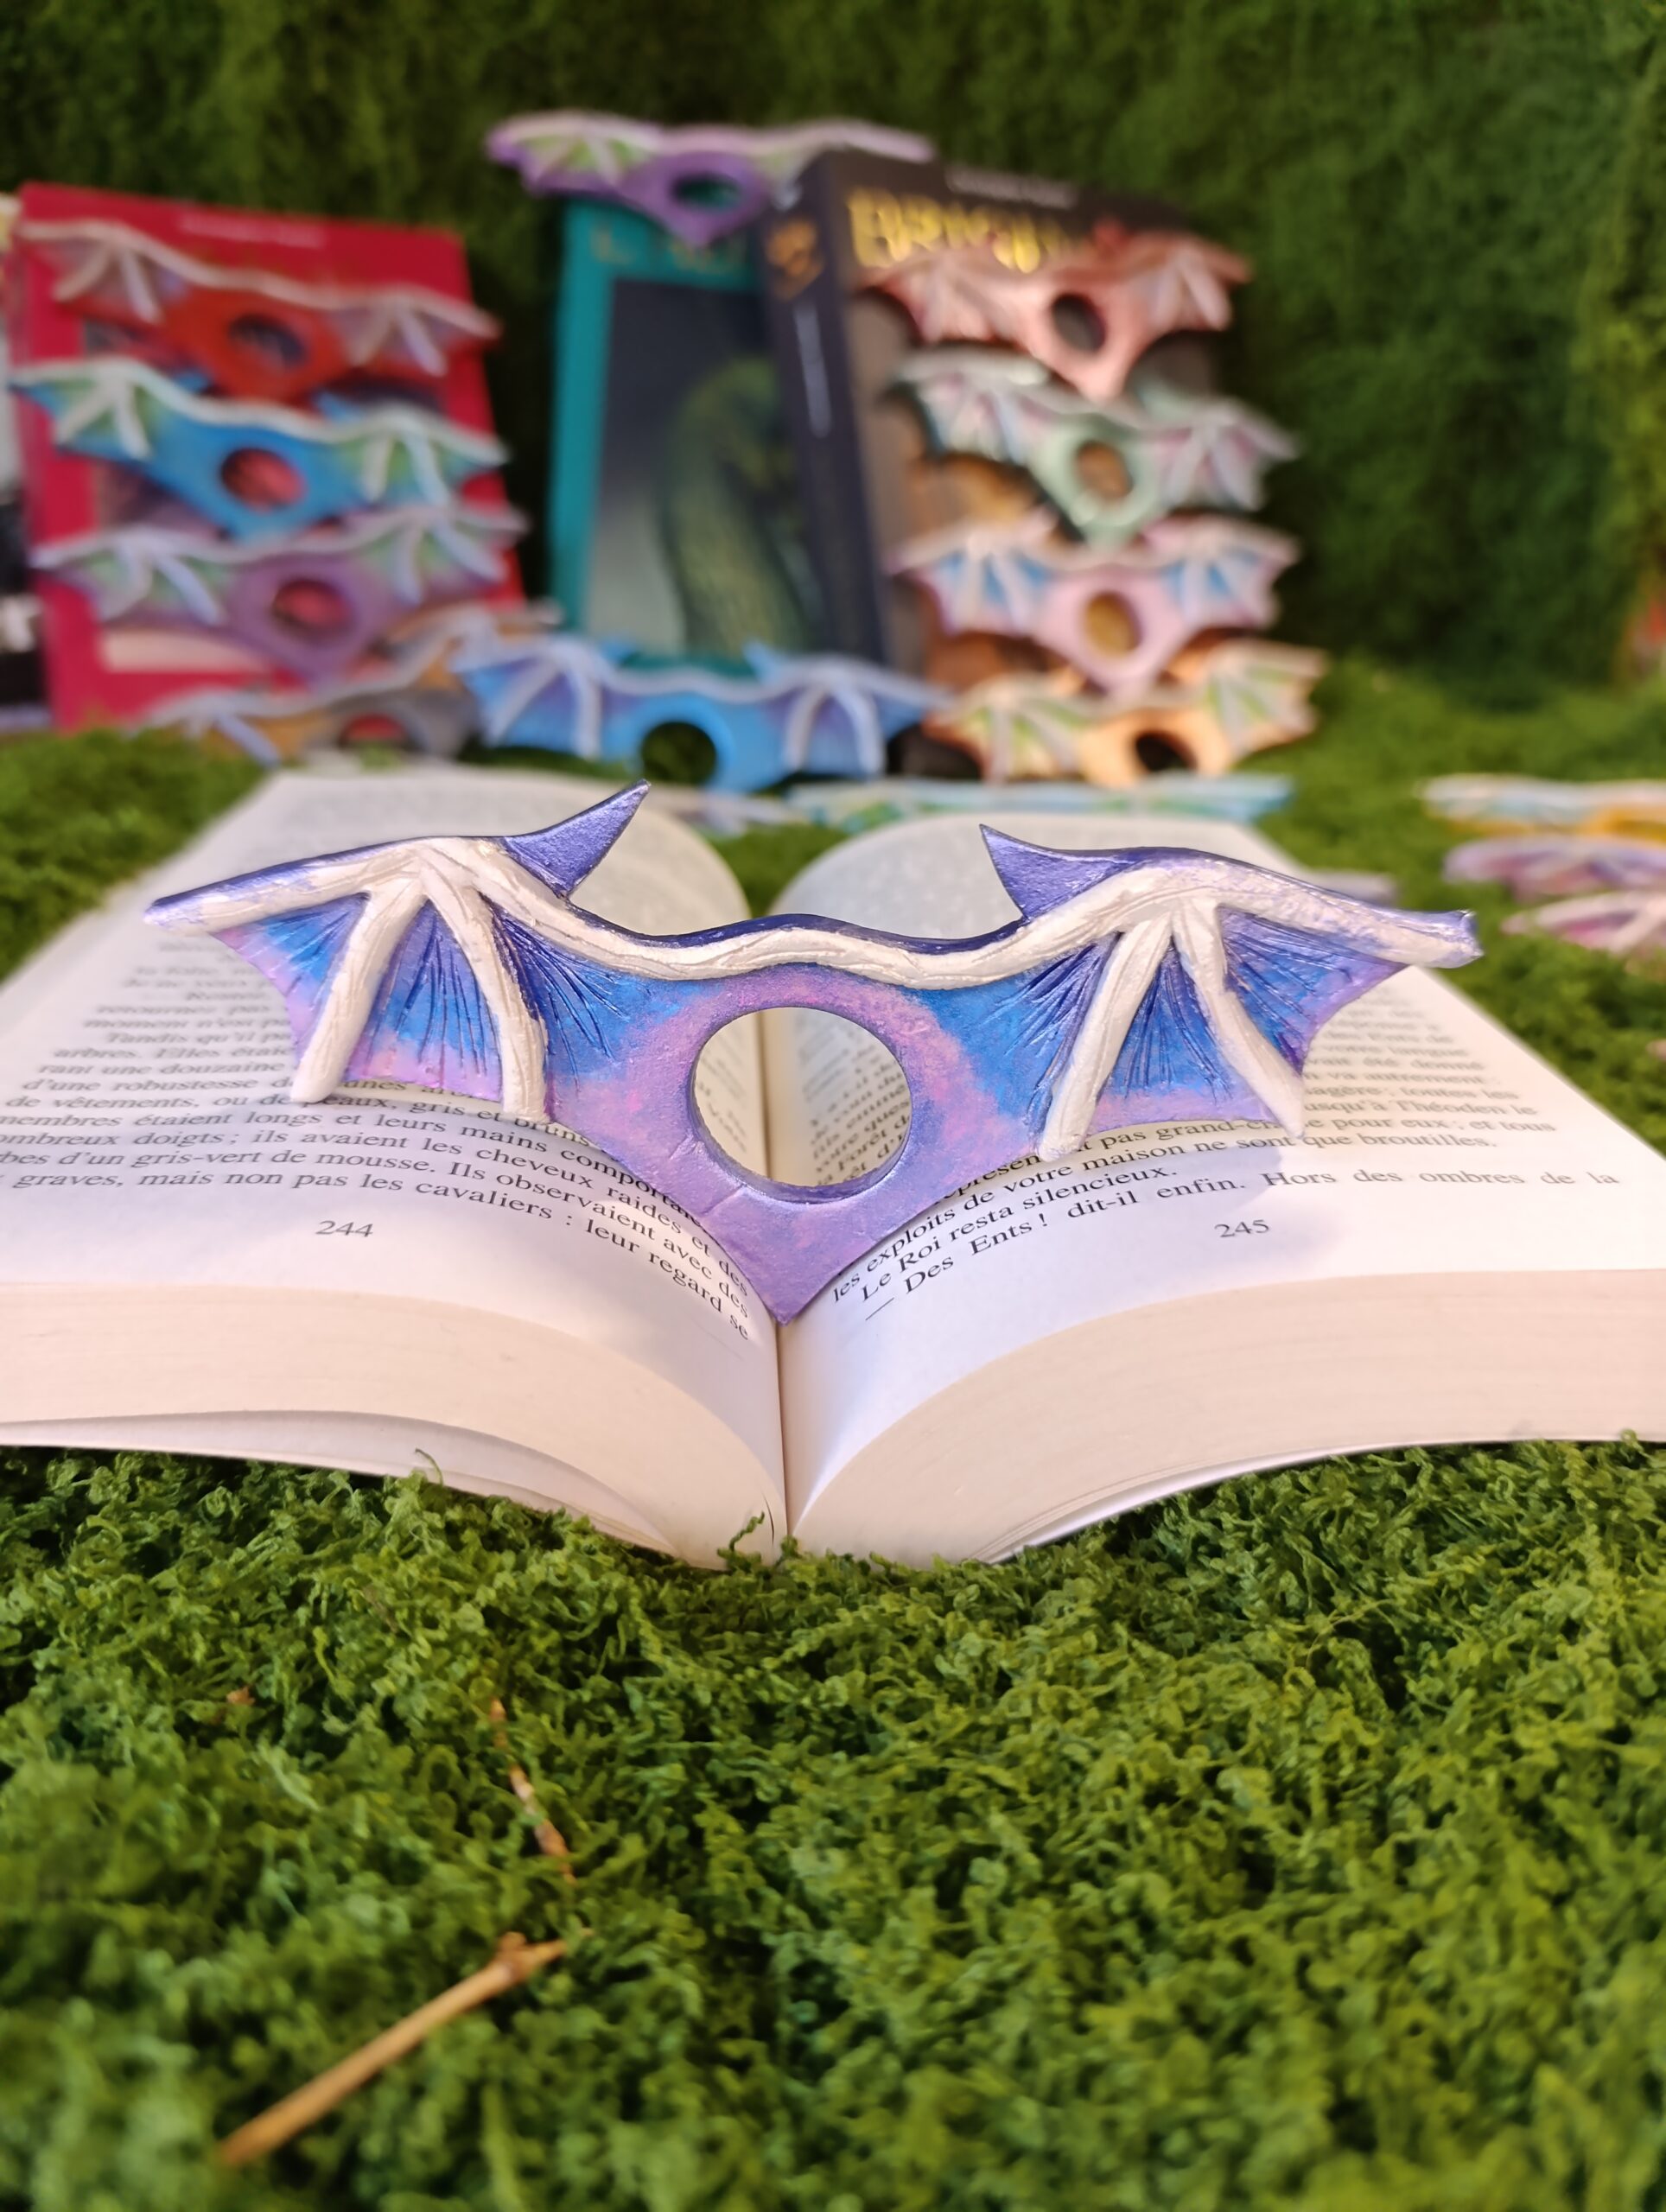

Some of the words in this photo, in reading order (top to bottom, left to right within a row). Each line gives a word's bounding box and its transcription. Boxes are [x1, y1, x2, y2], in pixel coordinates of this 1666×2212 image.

[22, 1078, 101, 1091] d'une
[111, 1078, 259, 1091] robustesse
[159, 1063, 284, 1075] douzaine
[5, 1096, 41, 1108] de
[53, 1096, 200, 1109] vêtements,
[213, 1096, 249, 1107] ou
[409, 1100, 466, 1115] gris
[477, 1109, 501, 1122] et
[1303, 1099, 1388, 1114] usqu'à
[133, 1112, 232, 1126] étaient
[245, 1111, 323, 1127] longs
[335, 1114, 362, 1125] et
[375, 1113, 447, 1133] leurs
[461, 1125, 547, 1153] mains
[1098, 1130, 1147, 1150] pas
[1331, 1118, 1393, 1131] pour
[1468, 1119, 1496, 1130] et
[1498, 1120, 1556, 1132] tous
[251, 1129, 289, 1143] ils
[302, 1131, 410, 1148] avaient
[421, 1137, 464, 1155] les
[476, 1148, 595, 1189] cheveux
[607, 1185, 682, 1234] raides
[691, 1235, 710, 1257] et
[718, 1258, 748, 1297] des
[315, 1219, 374, 1238] 244
[834, 1270, 861, 1303] les
[866, 1209, 956, 1274] exploits
[963, 1188, 995, 1211] de
[1003, 1165, 1074, 1193] votre
[1082, 1141, 1192, 1172] maison
[1193, 1140, 1226, 1154] ne
[1236, 1135, 1295, 1150] sont
[1301, 1133, 1354, 1148] que
[1358, 1132, 1498, 1148] broutilles.
[906, 1255, 955, 1294] Des
[1067, 1190, 1140, 1219] dit-il
[1156, 1178, 1247, 1199] enfin.
[1262, 1170, 1338, 1188] Hors
[1352, 1168, 1404, 1184] des
[1418, 1169, 1526, 1185] ombres
[1540, 1170, 1576, 1185] de
[1591, 1169, 1621, 1186] la
[1213, 1218, 1270, 1238] 245
[0, 1151, 51, 1165] bes
[57, 1151, 126, 1165] d'un
[130, 1149, 264, 1168] gris-vert
[270, 1149, 308, 1164] de
[315, 1153, 436, 1173] mousse.
[448, 1161, 486, 1181] Ils
[496, 1173, 656, 1241] observaient
[663, 1236, 713, 1280] avec
[718, 1281, 749, 1319] des
[861, 1271, 892, 1301] Le
[898, 1236, 943, 1273] Roi
[948, 1205, 1014, 1243] resta
[1022, 1165, 1178, 1211] silencieux.
[11, 1174, 124, 1189] graves,
[137, 1170, 214, 1185] mais
[224, 1173, 283, 1185] non
[291, 1173, 349, 1190] pas
[359, 1173, 404, 1191] les
[415, 1181, 552, 1220] cavaliers
[585, 1218, 640, 1254] leur
[648, 1251, 722, 1313] regard
[729, 1313, 750, 1341] se
